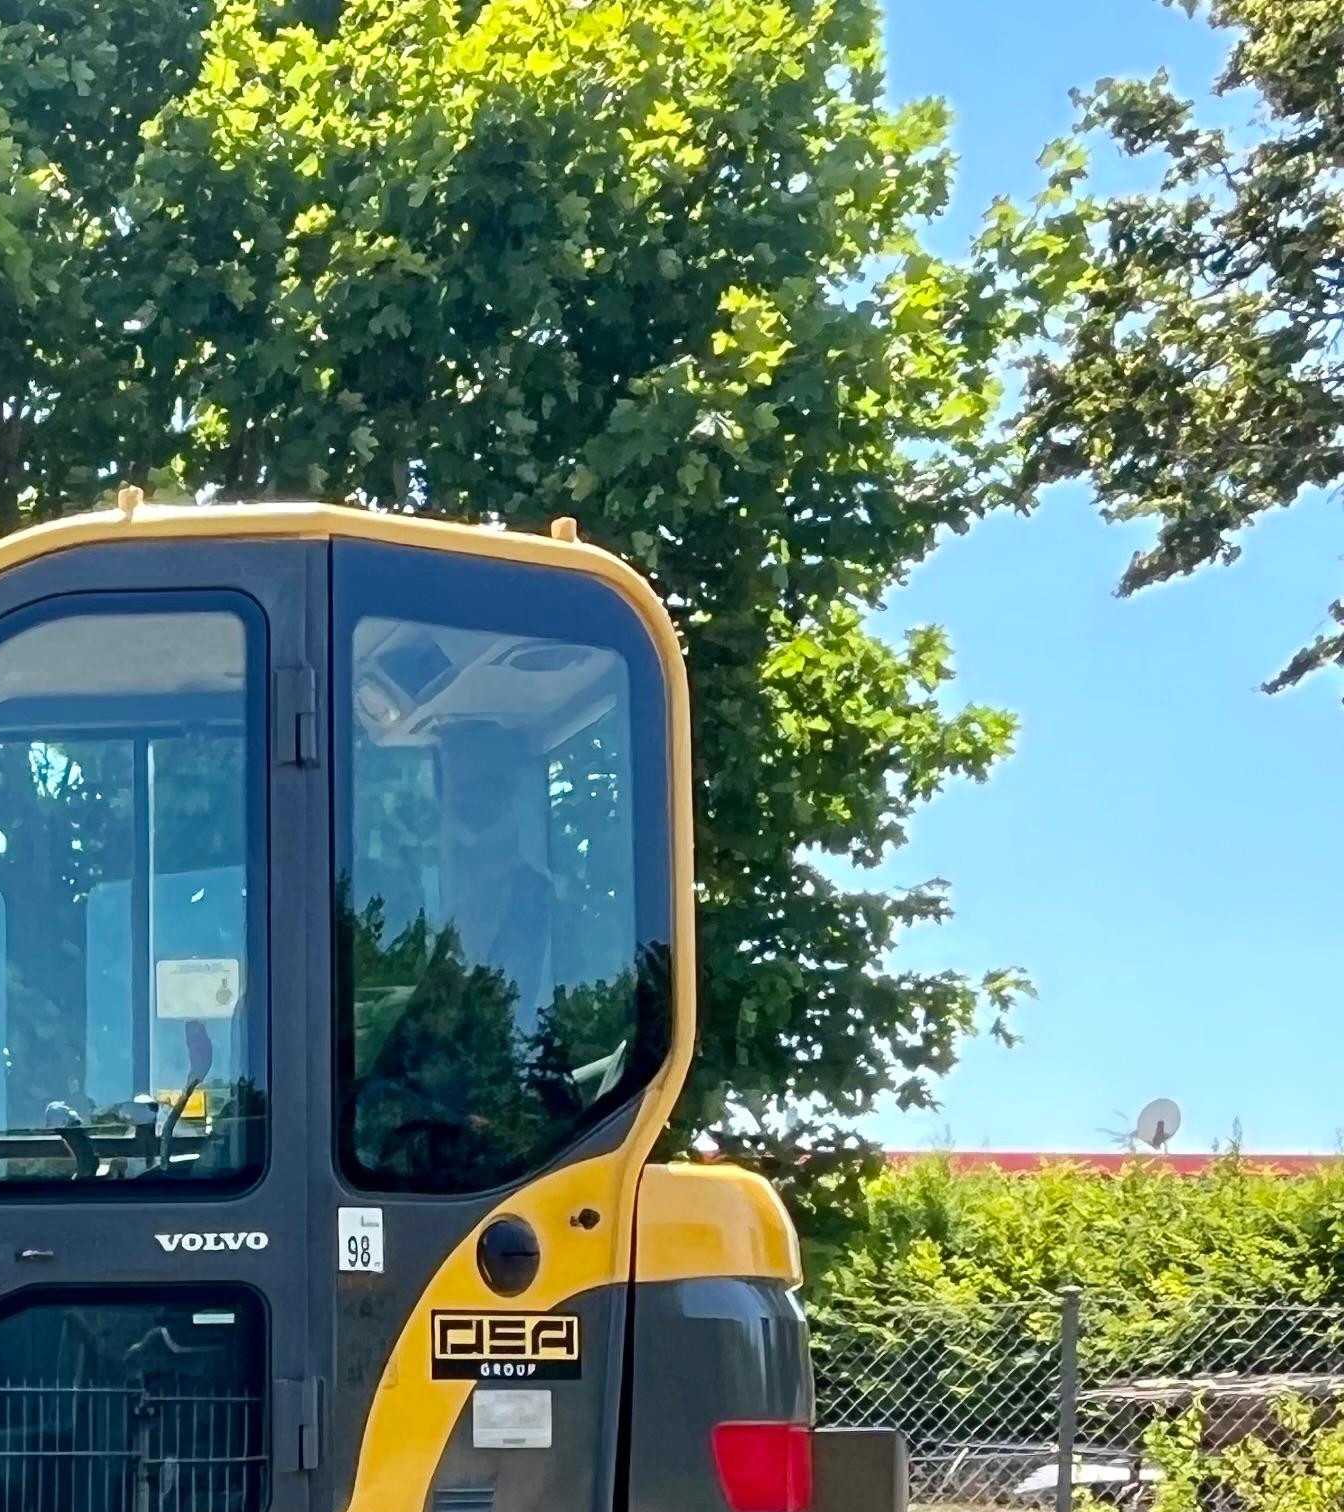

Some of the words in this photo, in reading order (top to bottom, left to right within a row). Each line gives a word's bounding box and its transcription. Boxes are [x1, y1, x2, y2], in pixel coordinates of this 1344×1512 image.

[154, 1231, 269, 1252] VOLVO
[347, 1235, 371, 1268] 98
[480, 1362, 537, 1377] GROUP
